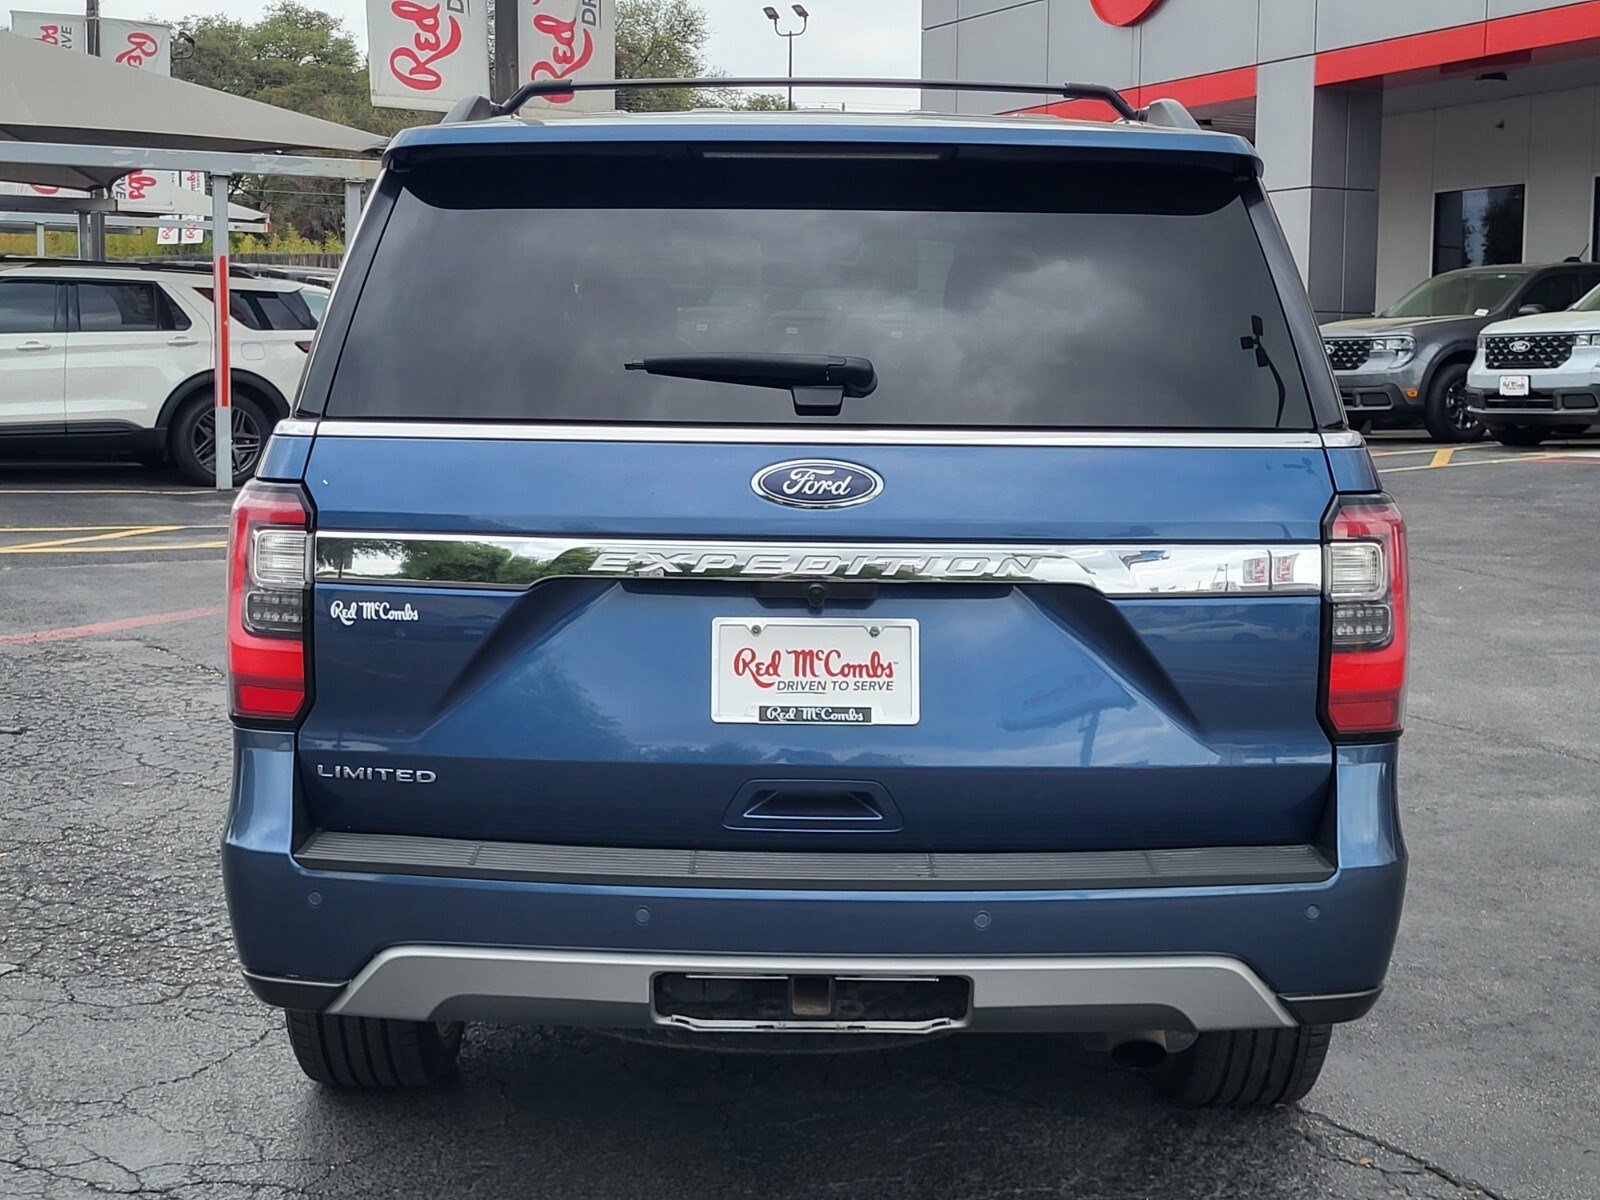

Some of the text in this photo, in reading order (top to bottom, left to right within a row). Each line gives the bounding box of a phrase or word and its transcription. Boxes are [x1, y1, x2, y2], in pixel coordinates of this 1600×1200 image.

[390, 0, 461, 90] Red
[531, 13, 594, 104] Red
[782, 468, 852, 497] Ford
[588, 551, 1040, 576] EXPEDITION
[330, 600, 419, 626] Red McCombs
[733, 647, 894, 688] Red McCombs
[776, 680, 894, 691] DRIVEN TO SERVE
[766, 706, 864, 722] Red McCombs
[317, 764, 437, 784] LIMITED
